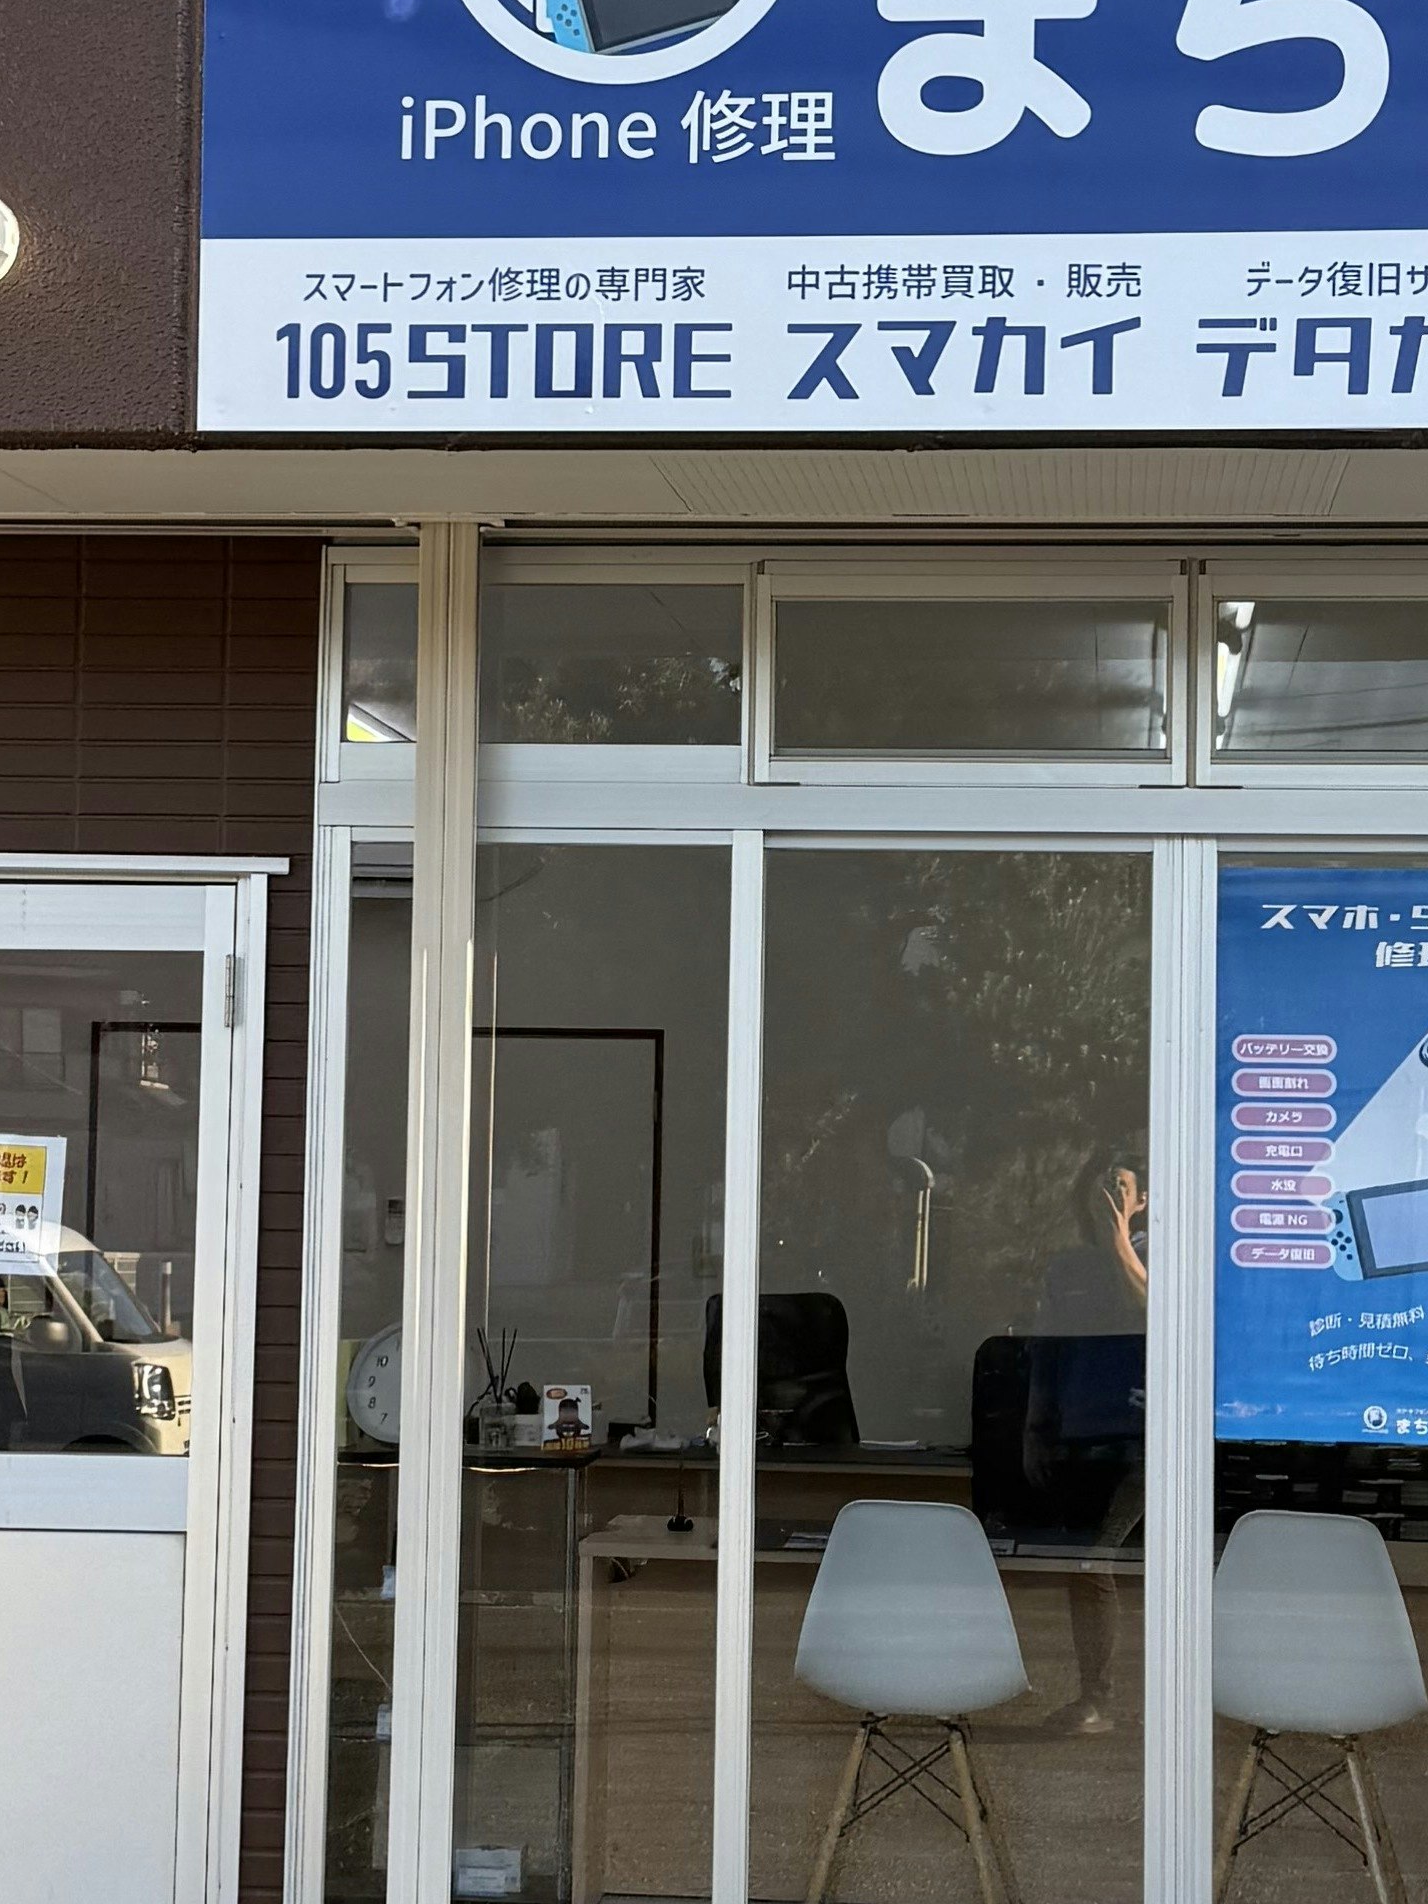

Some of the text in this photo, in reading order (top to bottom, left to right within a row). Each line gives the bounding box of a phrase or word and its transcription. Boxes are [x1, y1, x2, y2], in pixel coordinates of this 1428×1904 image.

[402, 90, 836, 164] iPhone 修理
[303, 266, 706, 303] スマートフォン修理の専門家
[786, 316, 1142, 400] スマカイ
[1266, 1110, 1303, 1123] カメラ
[376, 1355, 389, 1368] 10
[368, 1376, 376, 1388] 9
[368, 1397, 376, 1409] 8
